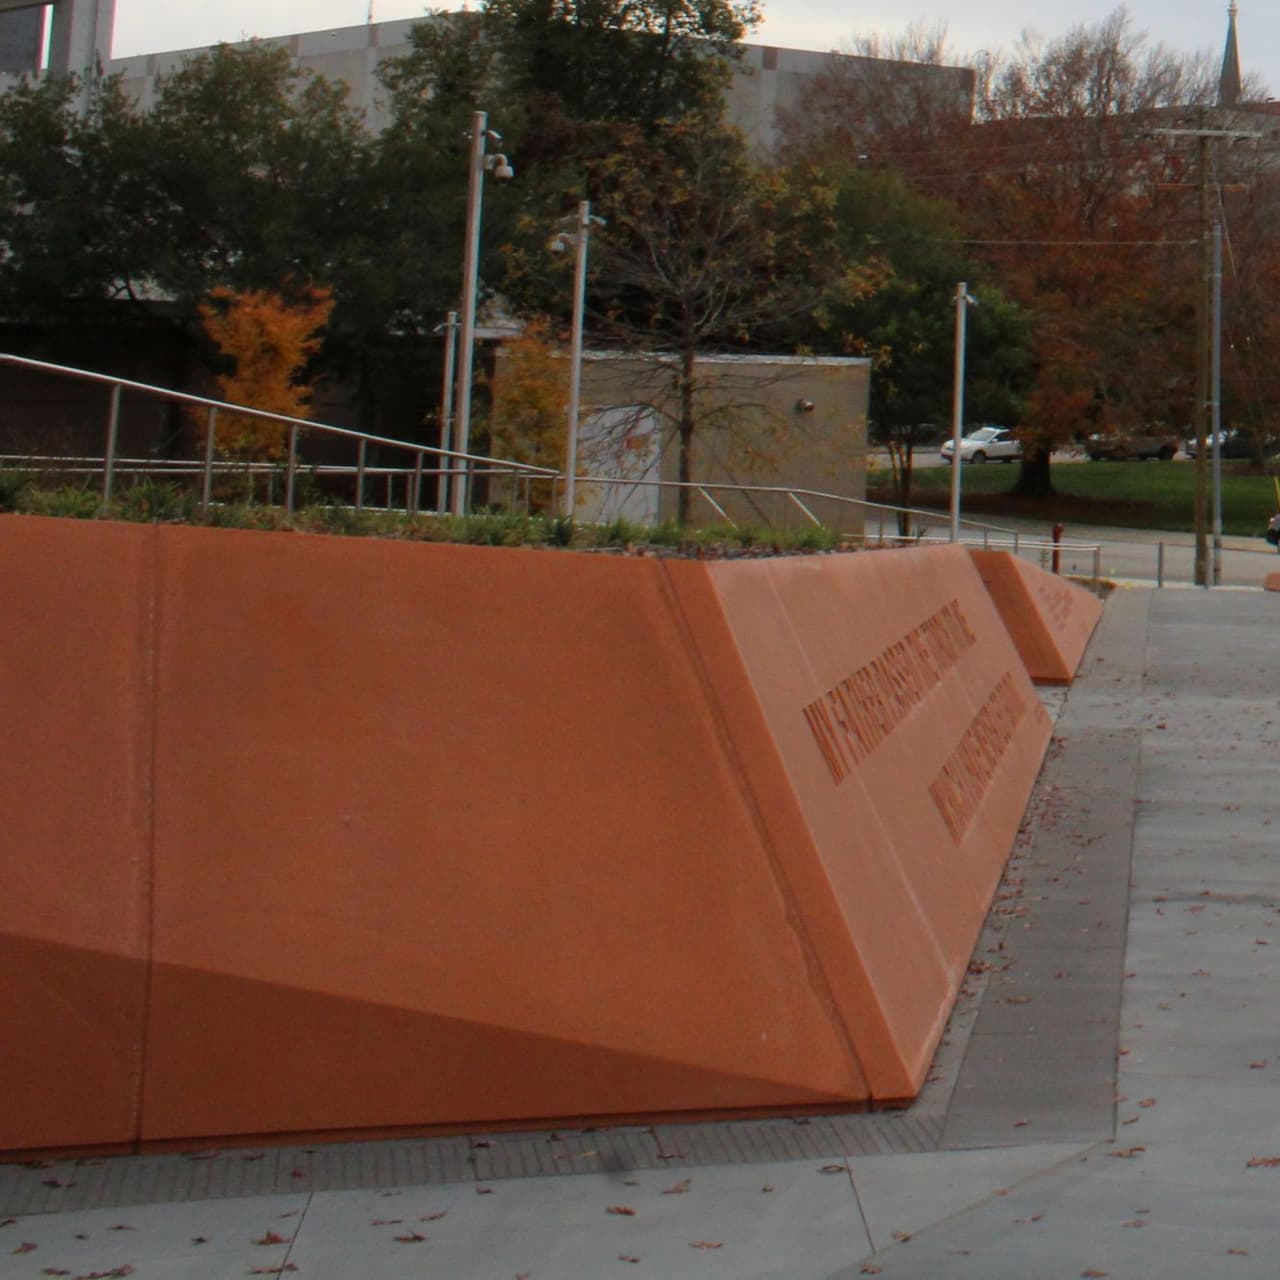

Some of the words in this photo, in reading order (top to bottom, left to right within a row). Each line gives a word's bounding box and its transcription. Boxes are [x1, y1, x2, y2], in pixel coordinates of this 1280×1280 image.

[824, 664, 895, 766] FATHER
[869, 639, 927, 723] PASSED
[801, 697, 853, 788] MY
